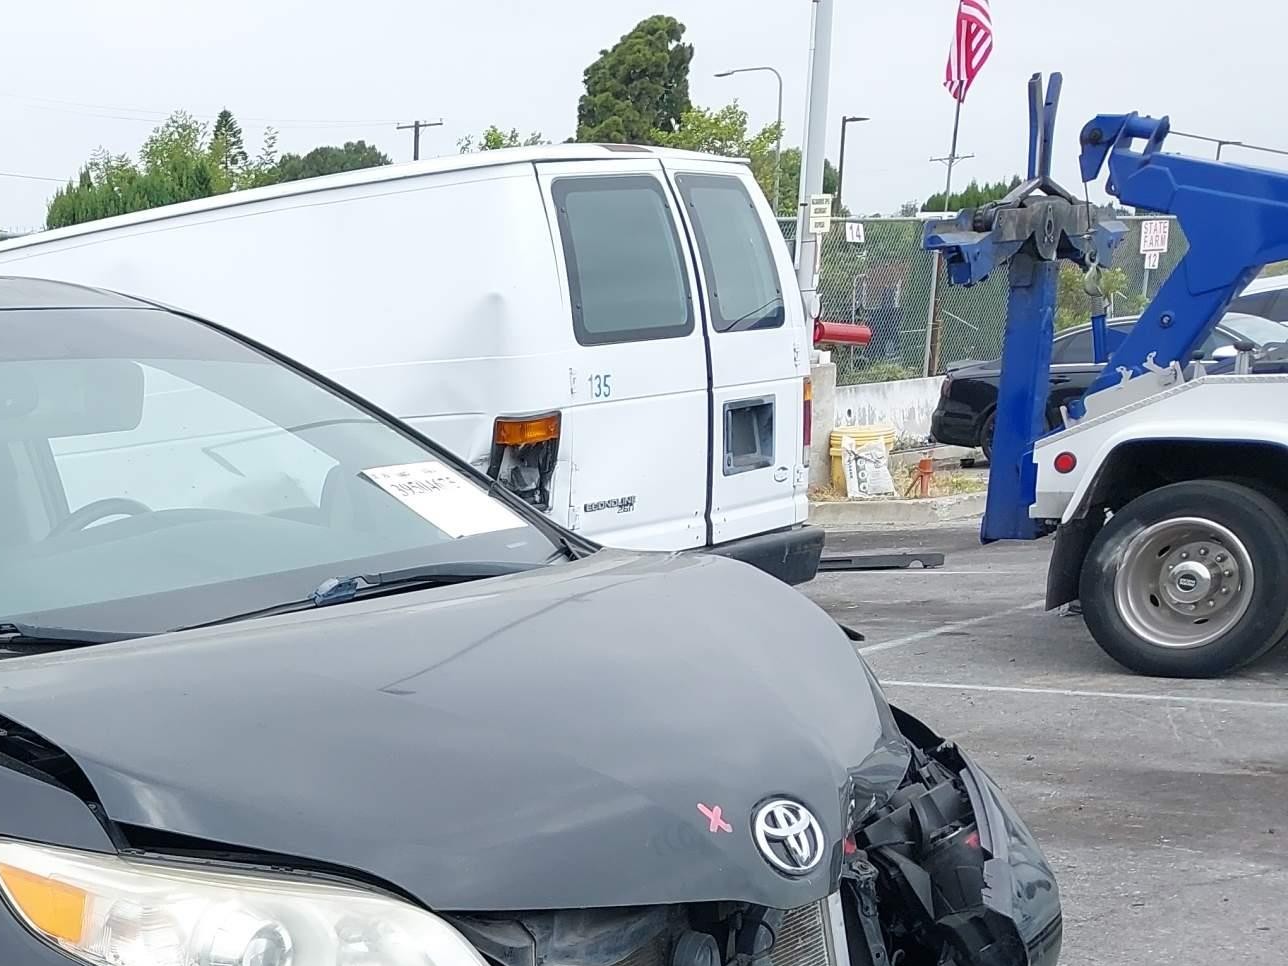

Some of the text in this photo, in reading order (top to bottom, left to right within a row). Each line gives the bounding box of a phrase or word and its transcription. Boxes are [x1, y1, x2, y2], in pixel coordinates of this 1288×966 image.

[849, 223, 862, 241] 14
[1143, 221, 1168, 235] STATE
[1143, 235, 1167, 249] FARM
[1147, 253, 1158, 268] 12
[587, 373, 612, 400] 135
